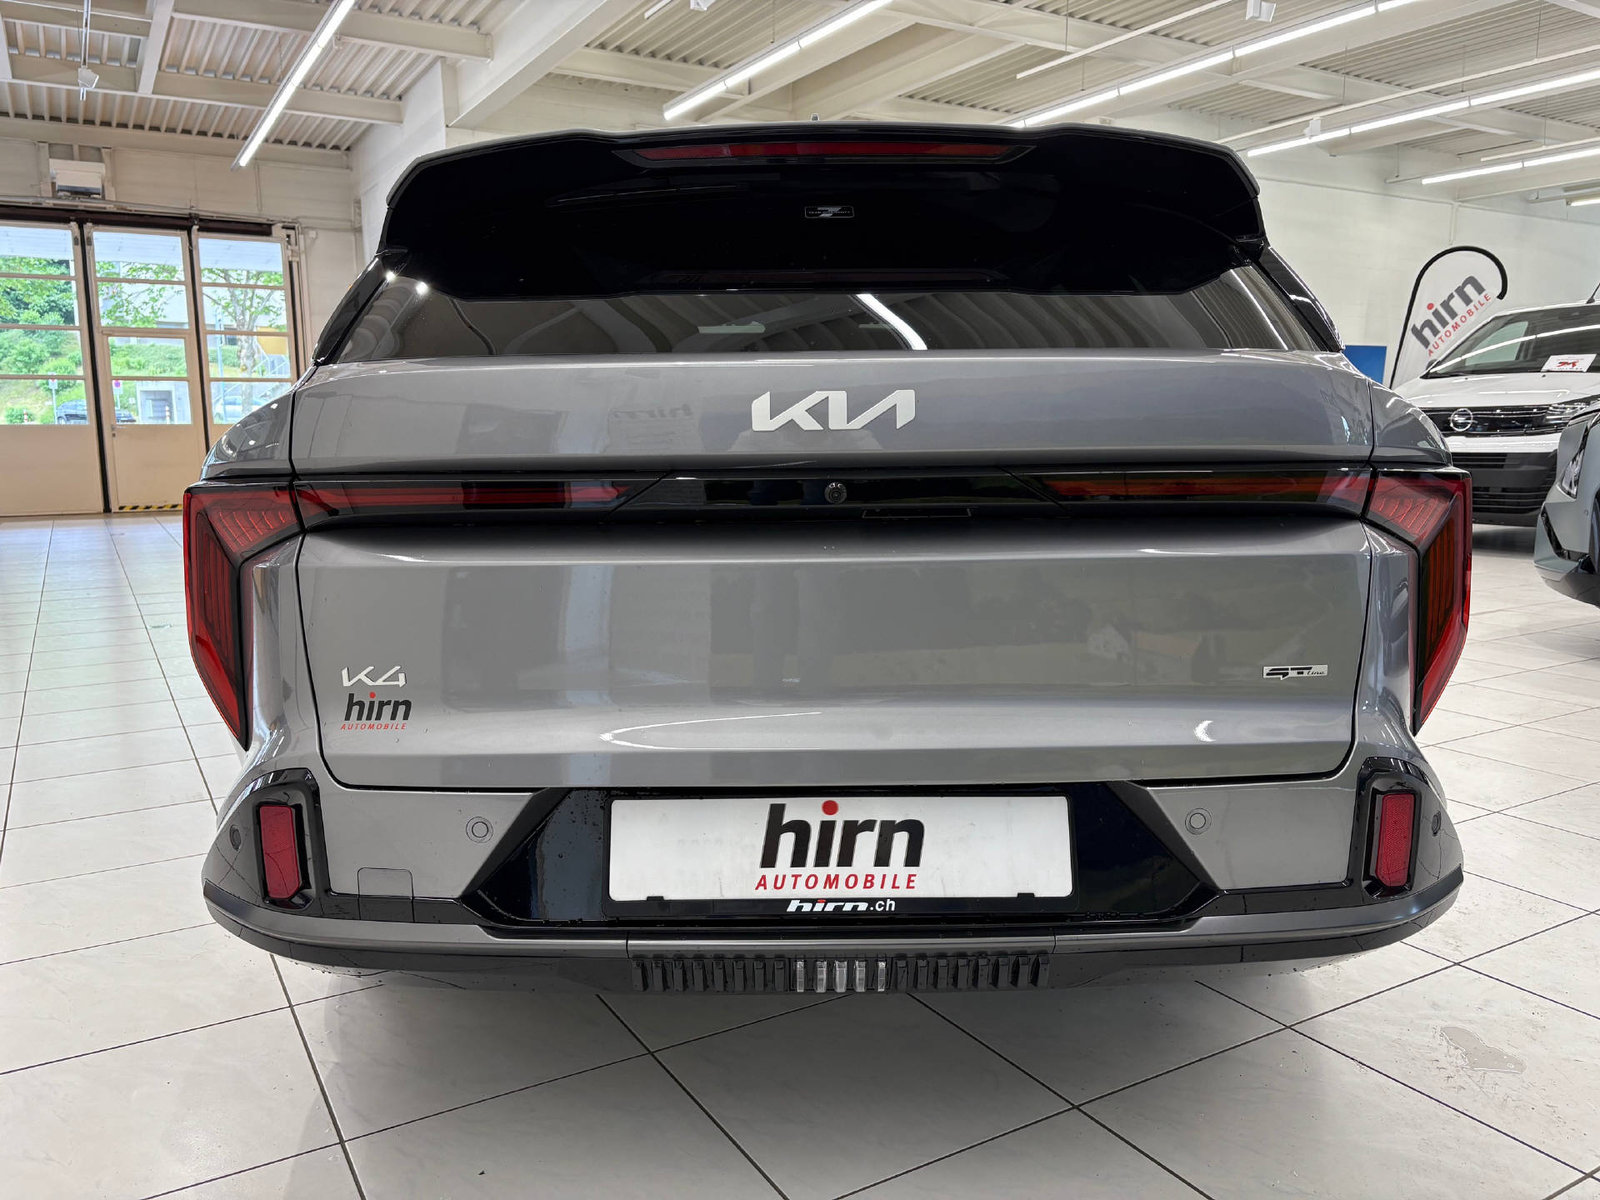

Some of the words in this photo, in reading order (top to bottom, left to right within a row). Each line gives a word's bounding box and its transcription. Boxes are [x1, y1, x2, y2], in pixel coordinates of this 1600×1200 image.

[1411, 275, 1486, 349] hirn
[1427, 293, 1492, 357] AUTOMOBILE
[751, 389, 916, 431] KIA
[341, 666, 407, 687] K4
[344, 691, 412, 721] hirn
[340, 722, 407, 731] AUTOMOBILE
[759, 799, 925, 868] hirn
[754, 872, 918, 891] AUTOMOBILE
[786, 898, 896, 912] hirn.ch
